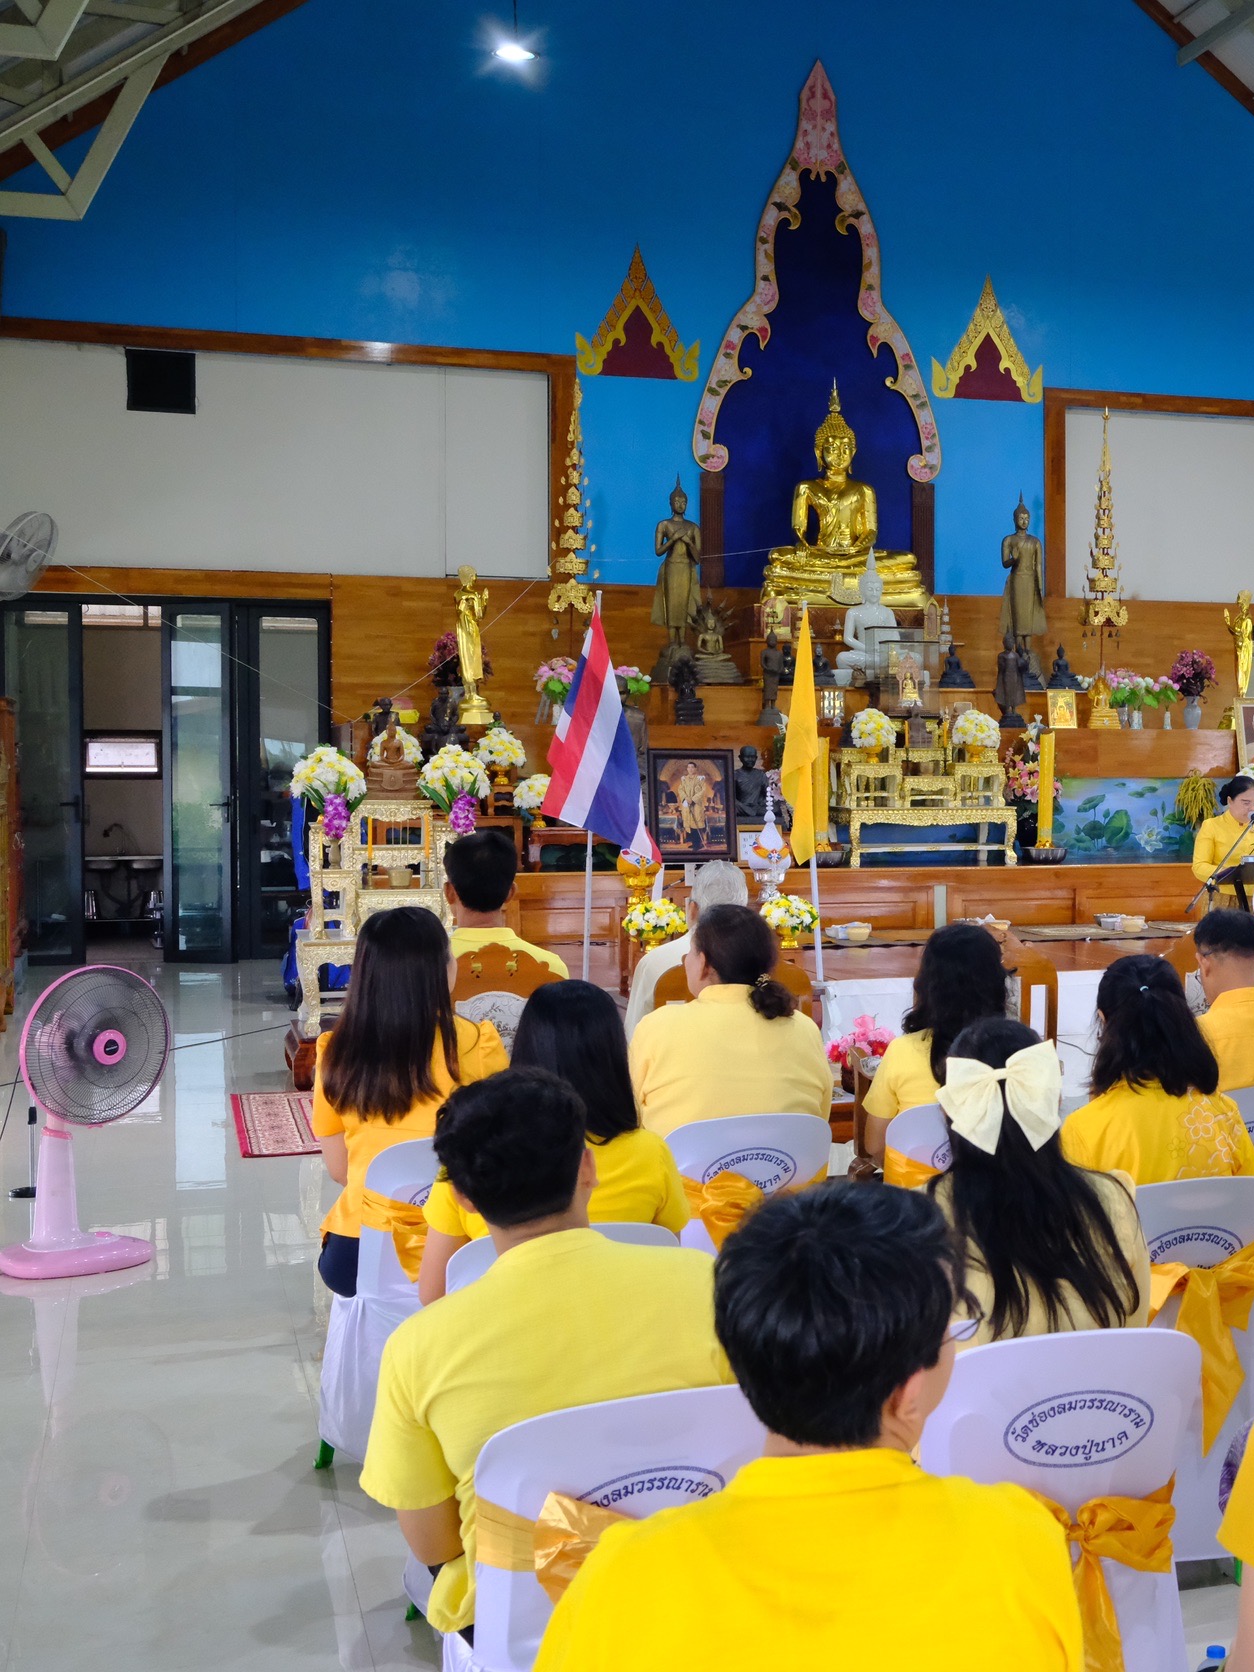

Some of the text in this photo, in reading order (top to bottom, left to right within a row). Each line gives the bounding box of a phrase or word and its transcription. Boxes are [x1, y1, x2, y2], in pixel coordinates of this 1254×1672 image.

[1011, 1398, 1146, 1443] วัดช่องลมวรรณาราม
[1032, 1430, 1129, 1461] หลวงปู่นาค
